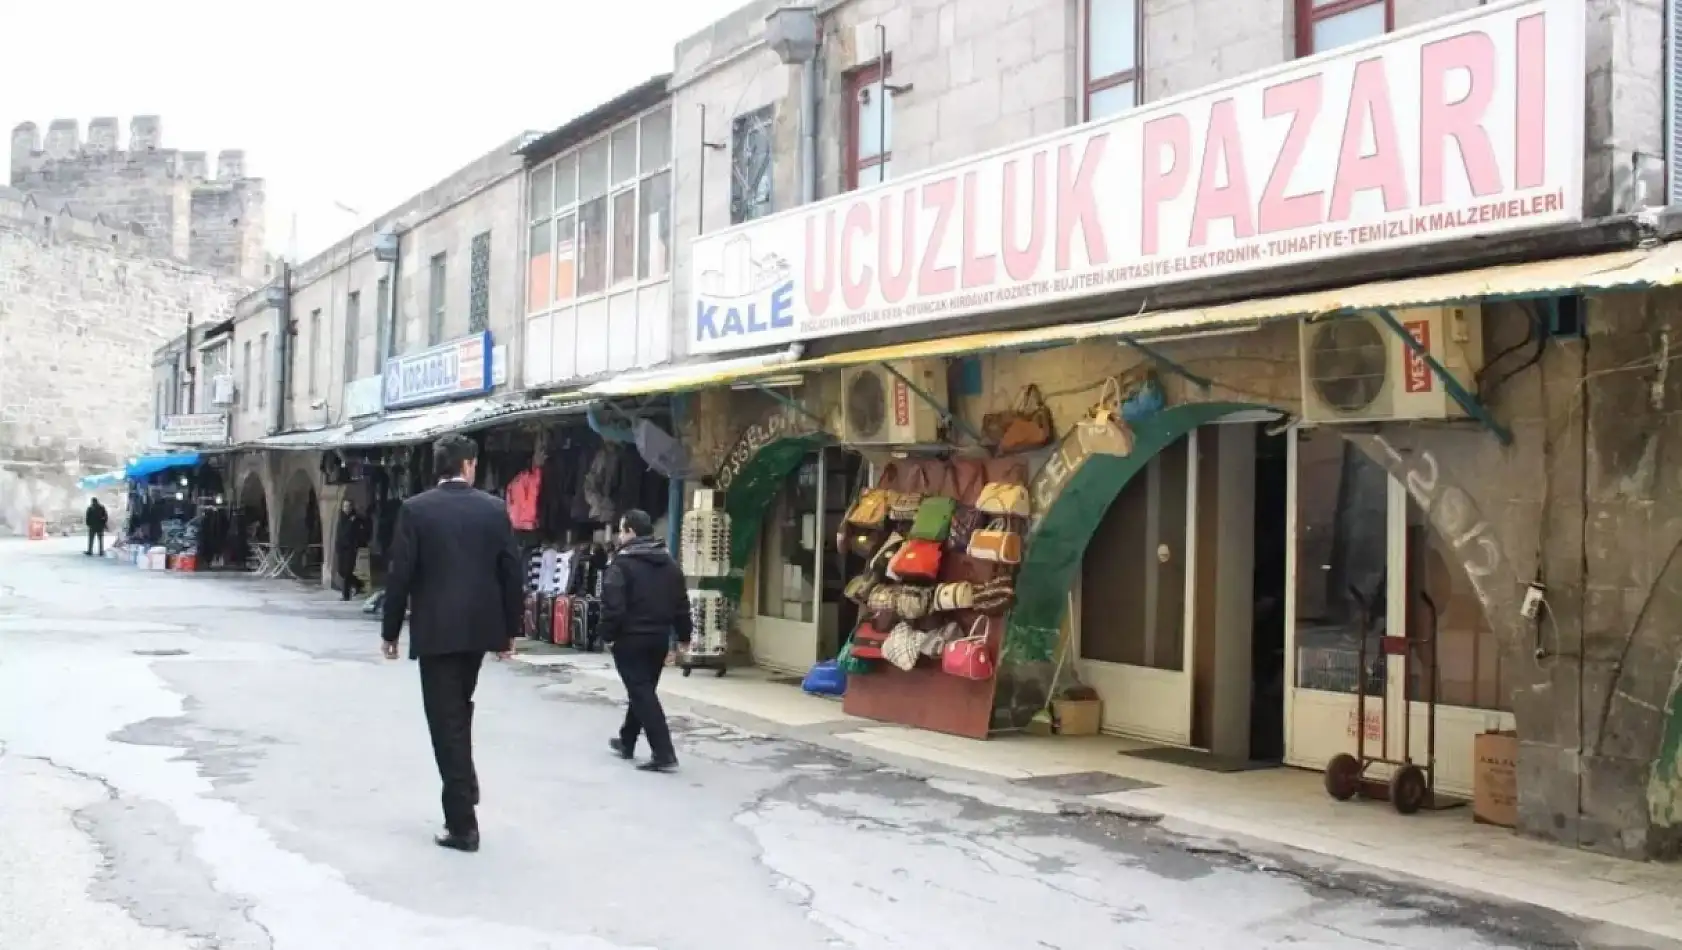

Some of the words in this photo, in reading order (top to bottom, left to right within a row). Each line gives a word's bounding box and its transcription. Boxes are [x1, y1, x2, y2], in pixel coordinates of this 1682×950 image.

[803, 132, 1110, 316] UCUZLUK
[1141, 12, 1546, 257] PAZARI
[1429, 188, 1565, 231] MALZEMELERİ
[695, 279, 795, 342] KALE
